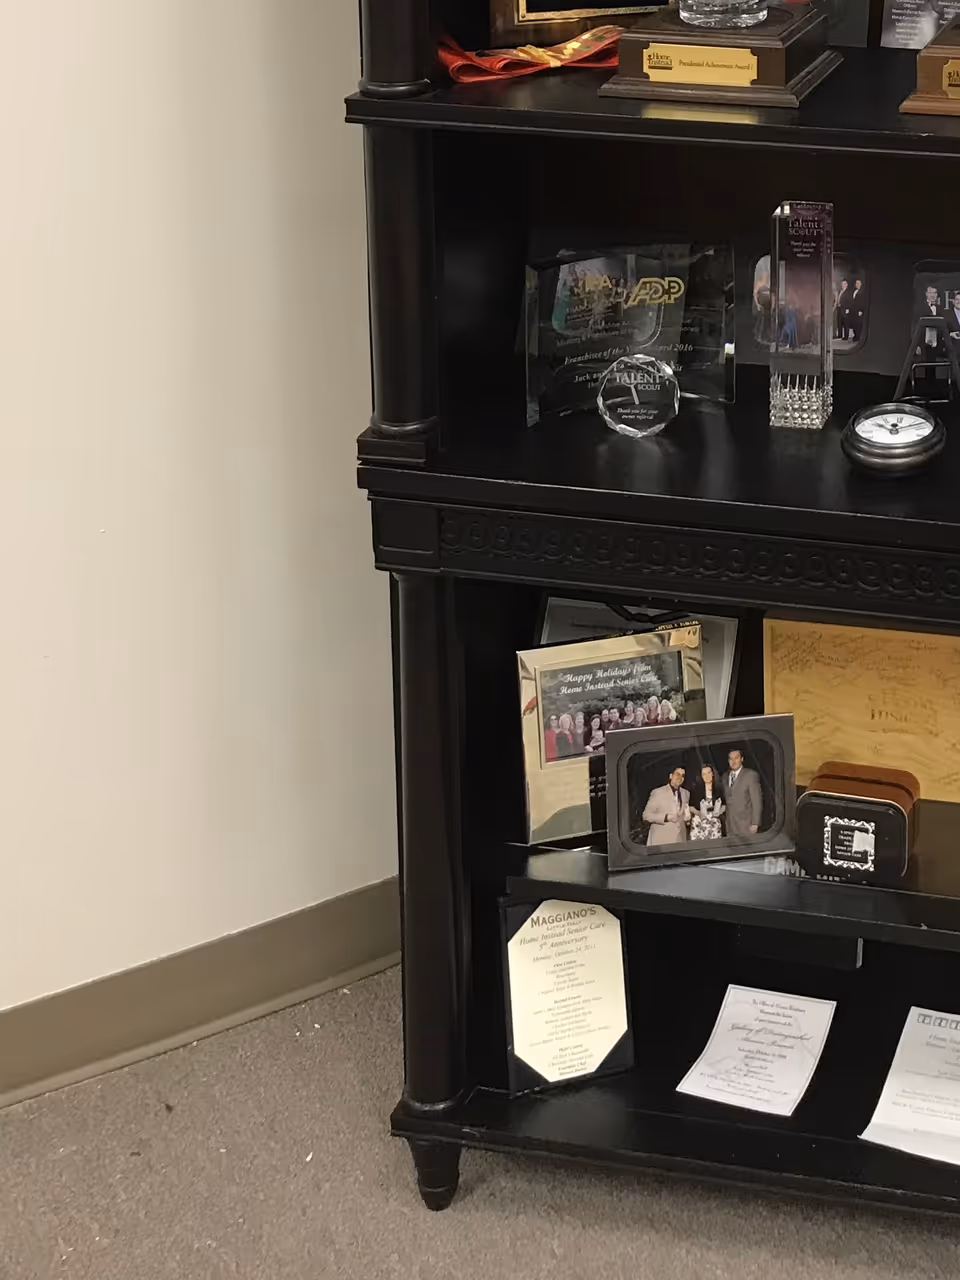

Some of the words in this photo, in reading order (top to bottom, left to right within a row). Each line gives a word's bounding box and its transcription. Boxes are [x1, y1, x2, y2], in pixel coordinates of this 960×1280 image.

[628, 277, 685, 306] ADP
[673, 343, 694, 352] 2016
[614, 373, 661, 384] TALENT
[637, 383, 661, 391] SCOUT
[563, 673, 593, 684] Happy
[595, 667, 631, 678] Holidays
[559, 686, 583, 695] Home
[584, 679, 614, 691] Instead
[530, 906, 597, 928] MAGGIANO'S
